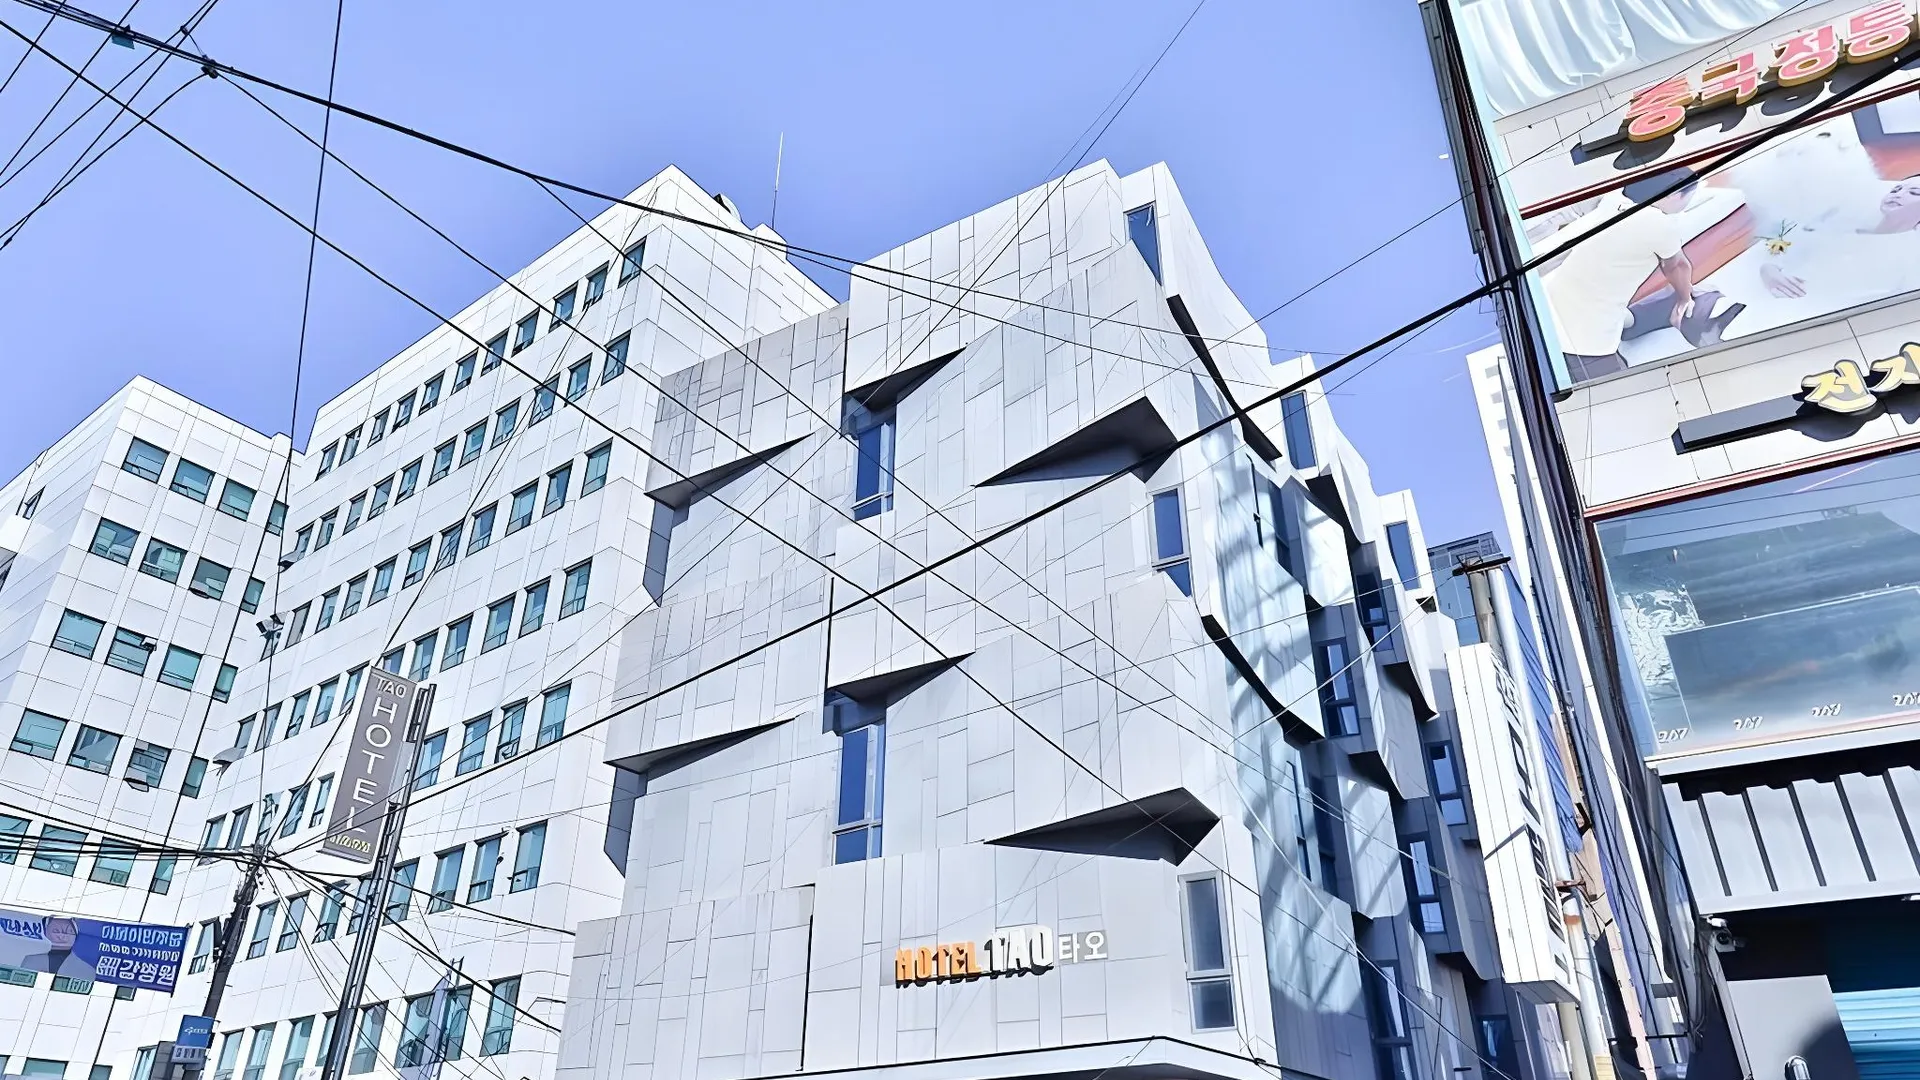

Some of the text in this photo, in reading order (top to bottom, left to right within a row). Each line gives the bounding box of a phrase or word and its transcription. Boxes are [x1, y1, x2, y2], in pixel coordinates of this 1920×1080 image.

[376, 676, 407, 698] TAO
[345, 696, 399, 834] HOTEL
[895, 925, 1054, 984] HOTEL TAO
[1058, 930, 1108, 964] 타오
